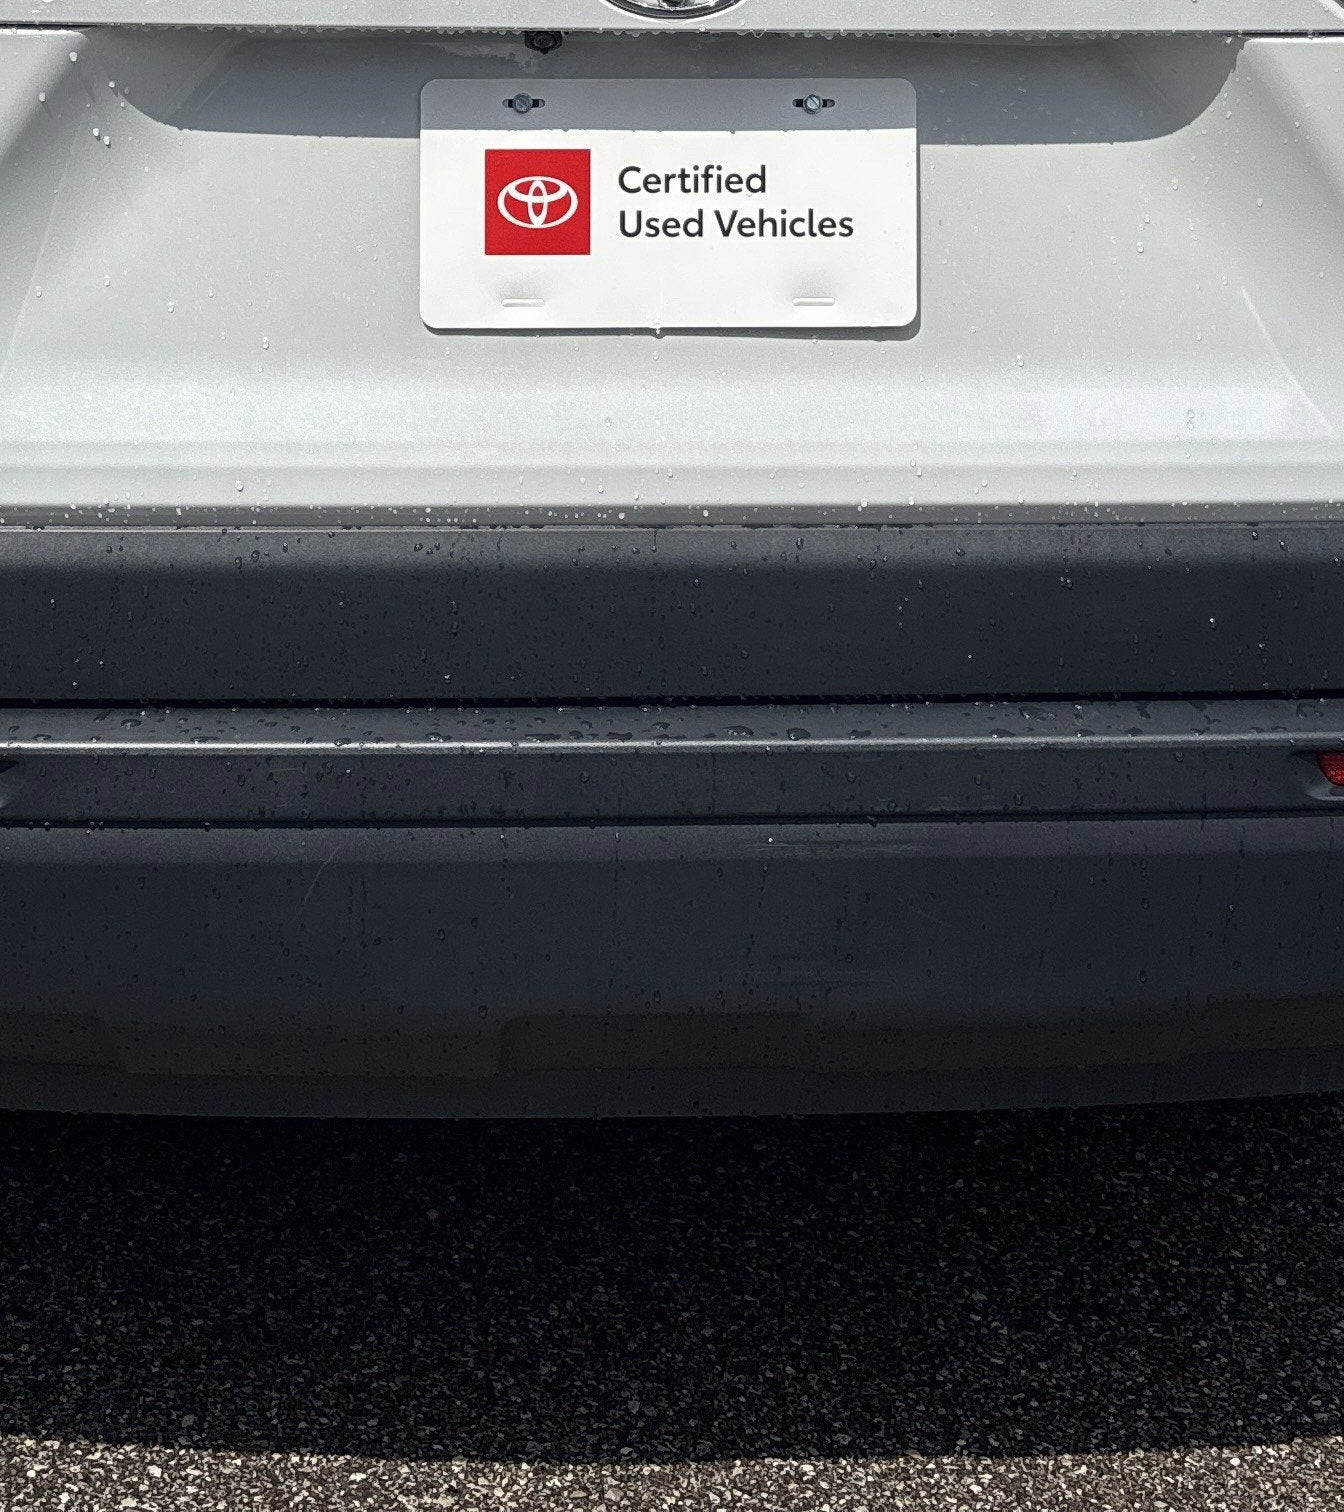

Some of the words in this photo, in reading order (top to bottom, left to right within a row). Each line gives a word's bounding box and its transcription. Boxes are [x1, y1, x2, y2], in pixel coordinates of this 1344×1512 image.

[618, 164, 766, 194] Certified
[619, 208, 704, 238] Used
[713, 208, 854, 238] Vehicles
